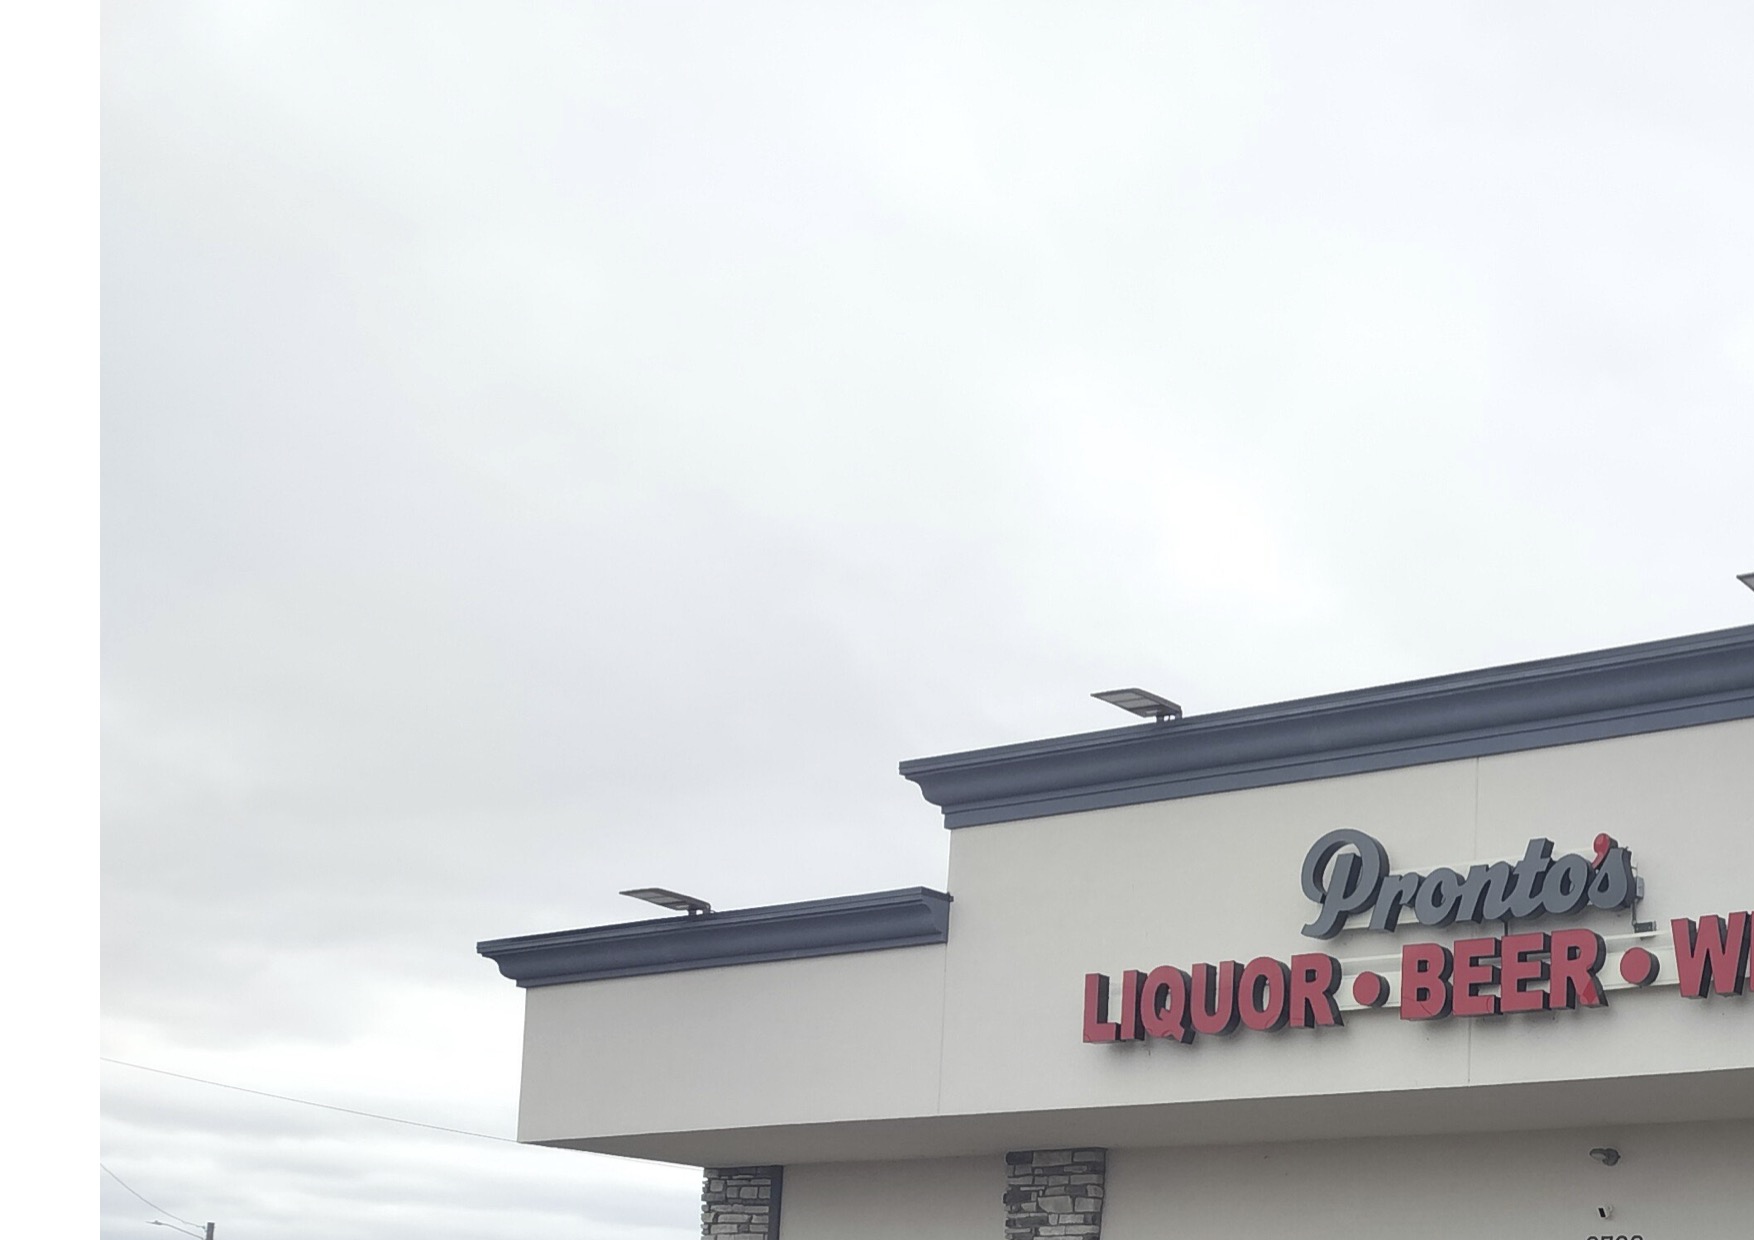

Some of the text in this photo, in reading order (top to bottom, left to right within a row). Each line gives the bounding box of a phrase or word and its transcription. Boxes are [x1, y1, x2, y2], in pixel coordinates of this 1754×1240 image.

[1301, 828, 1638, 940] Pronto's
[1083, 952, 1344, 1045] LIQUOR
[1400, 928, 1608, 1022] BEER
